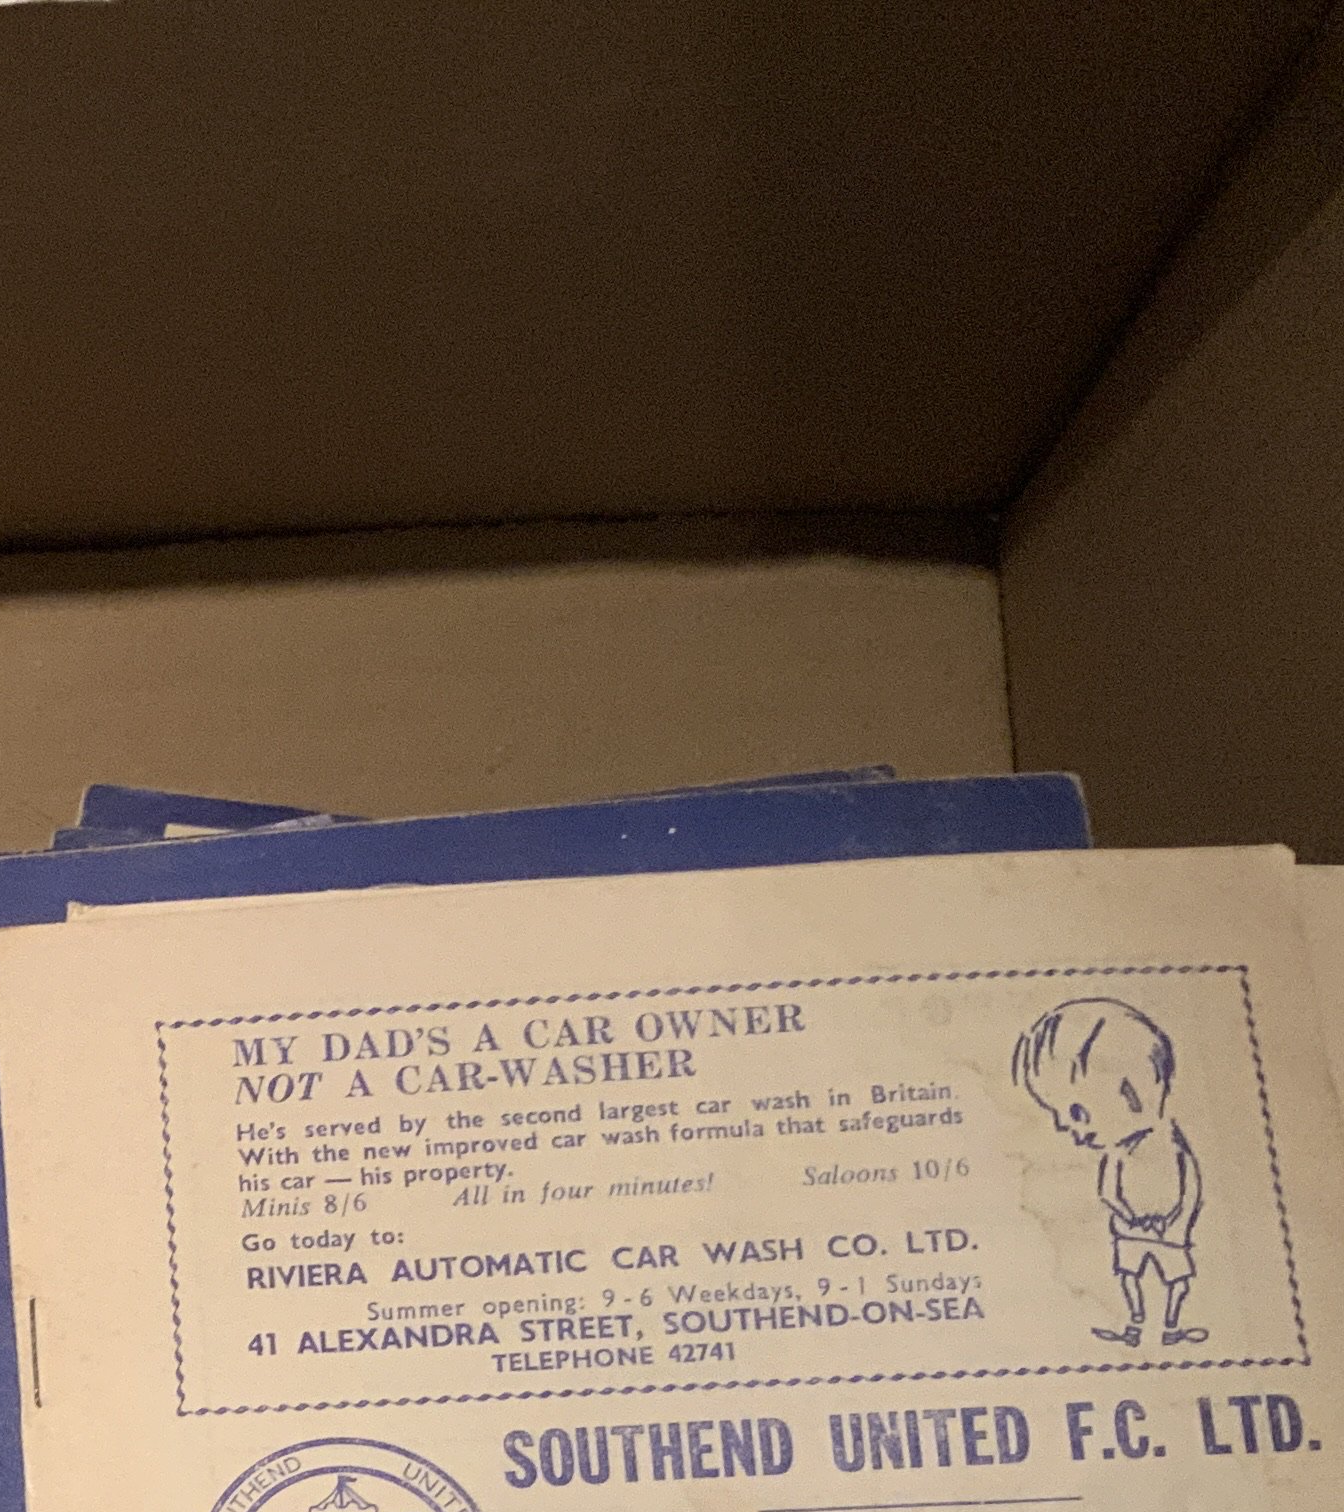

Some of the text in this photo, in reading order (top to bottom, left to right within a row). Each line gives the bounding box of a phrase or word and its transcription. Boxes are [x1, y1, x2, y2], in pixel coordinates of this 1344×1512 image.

[234, 1004, 805, 1067] MY DAD'S A CAR OWNER
[236, 1049, 696, 1104] NOT A CAR-WASHER
[238, 1107, 963, 1166] With the new improved car wash formula that safeguards
[305, 1116, 381, 1138] served
[400, 1115, 426, 1136] by
[446, 1111, 484, 1129] the
[501, 1104, 582, 1126] second
[599, 1101, 679, 1123] largest
[696, 1100, 731, 1114] car
[751, 1090, 810, 1111] wash
[828, 1088, 850, 1106] in
[239, 1174, 270, 1192] his
[281, 1176, 315, 1190] car
[360, 1167, 392, 1186] his
[453, 1185, 488, 1206] All
[503, 1185, 525, 1203] in
[540, 1181, 594, 1205] four
[803, 1159, 969, 1186] Saloons 10/6
[242, 1193, 367, 1218] Minis 8/6
[242, 1234, 276, 1252] Go
[291, 1229, 355, 1252] today
[247, 1262, 367, 1289] RIVIERA
[391, 1249, 587, 1282] AUTOMATIC
[612, 1245, 679, 1269] CAR
[702, 1238, 803, 1263] WASH
[367, 1301, 465, 1321] Summer
[483, 1293, 584, 1319] opening:
[886, 1272, 981, 1295] Sundays
[248, 1296, 986, 1356] 41 ALEXANDRA STREET, SOUTHEND-ON-SEA
[491, 1342, 735, 1372] TELEPHONE 42741
[504, 1394, 1321, 1489] SOUTHEND UNITED F.C. LTD.
